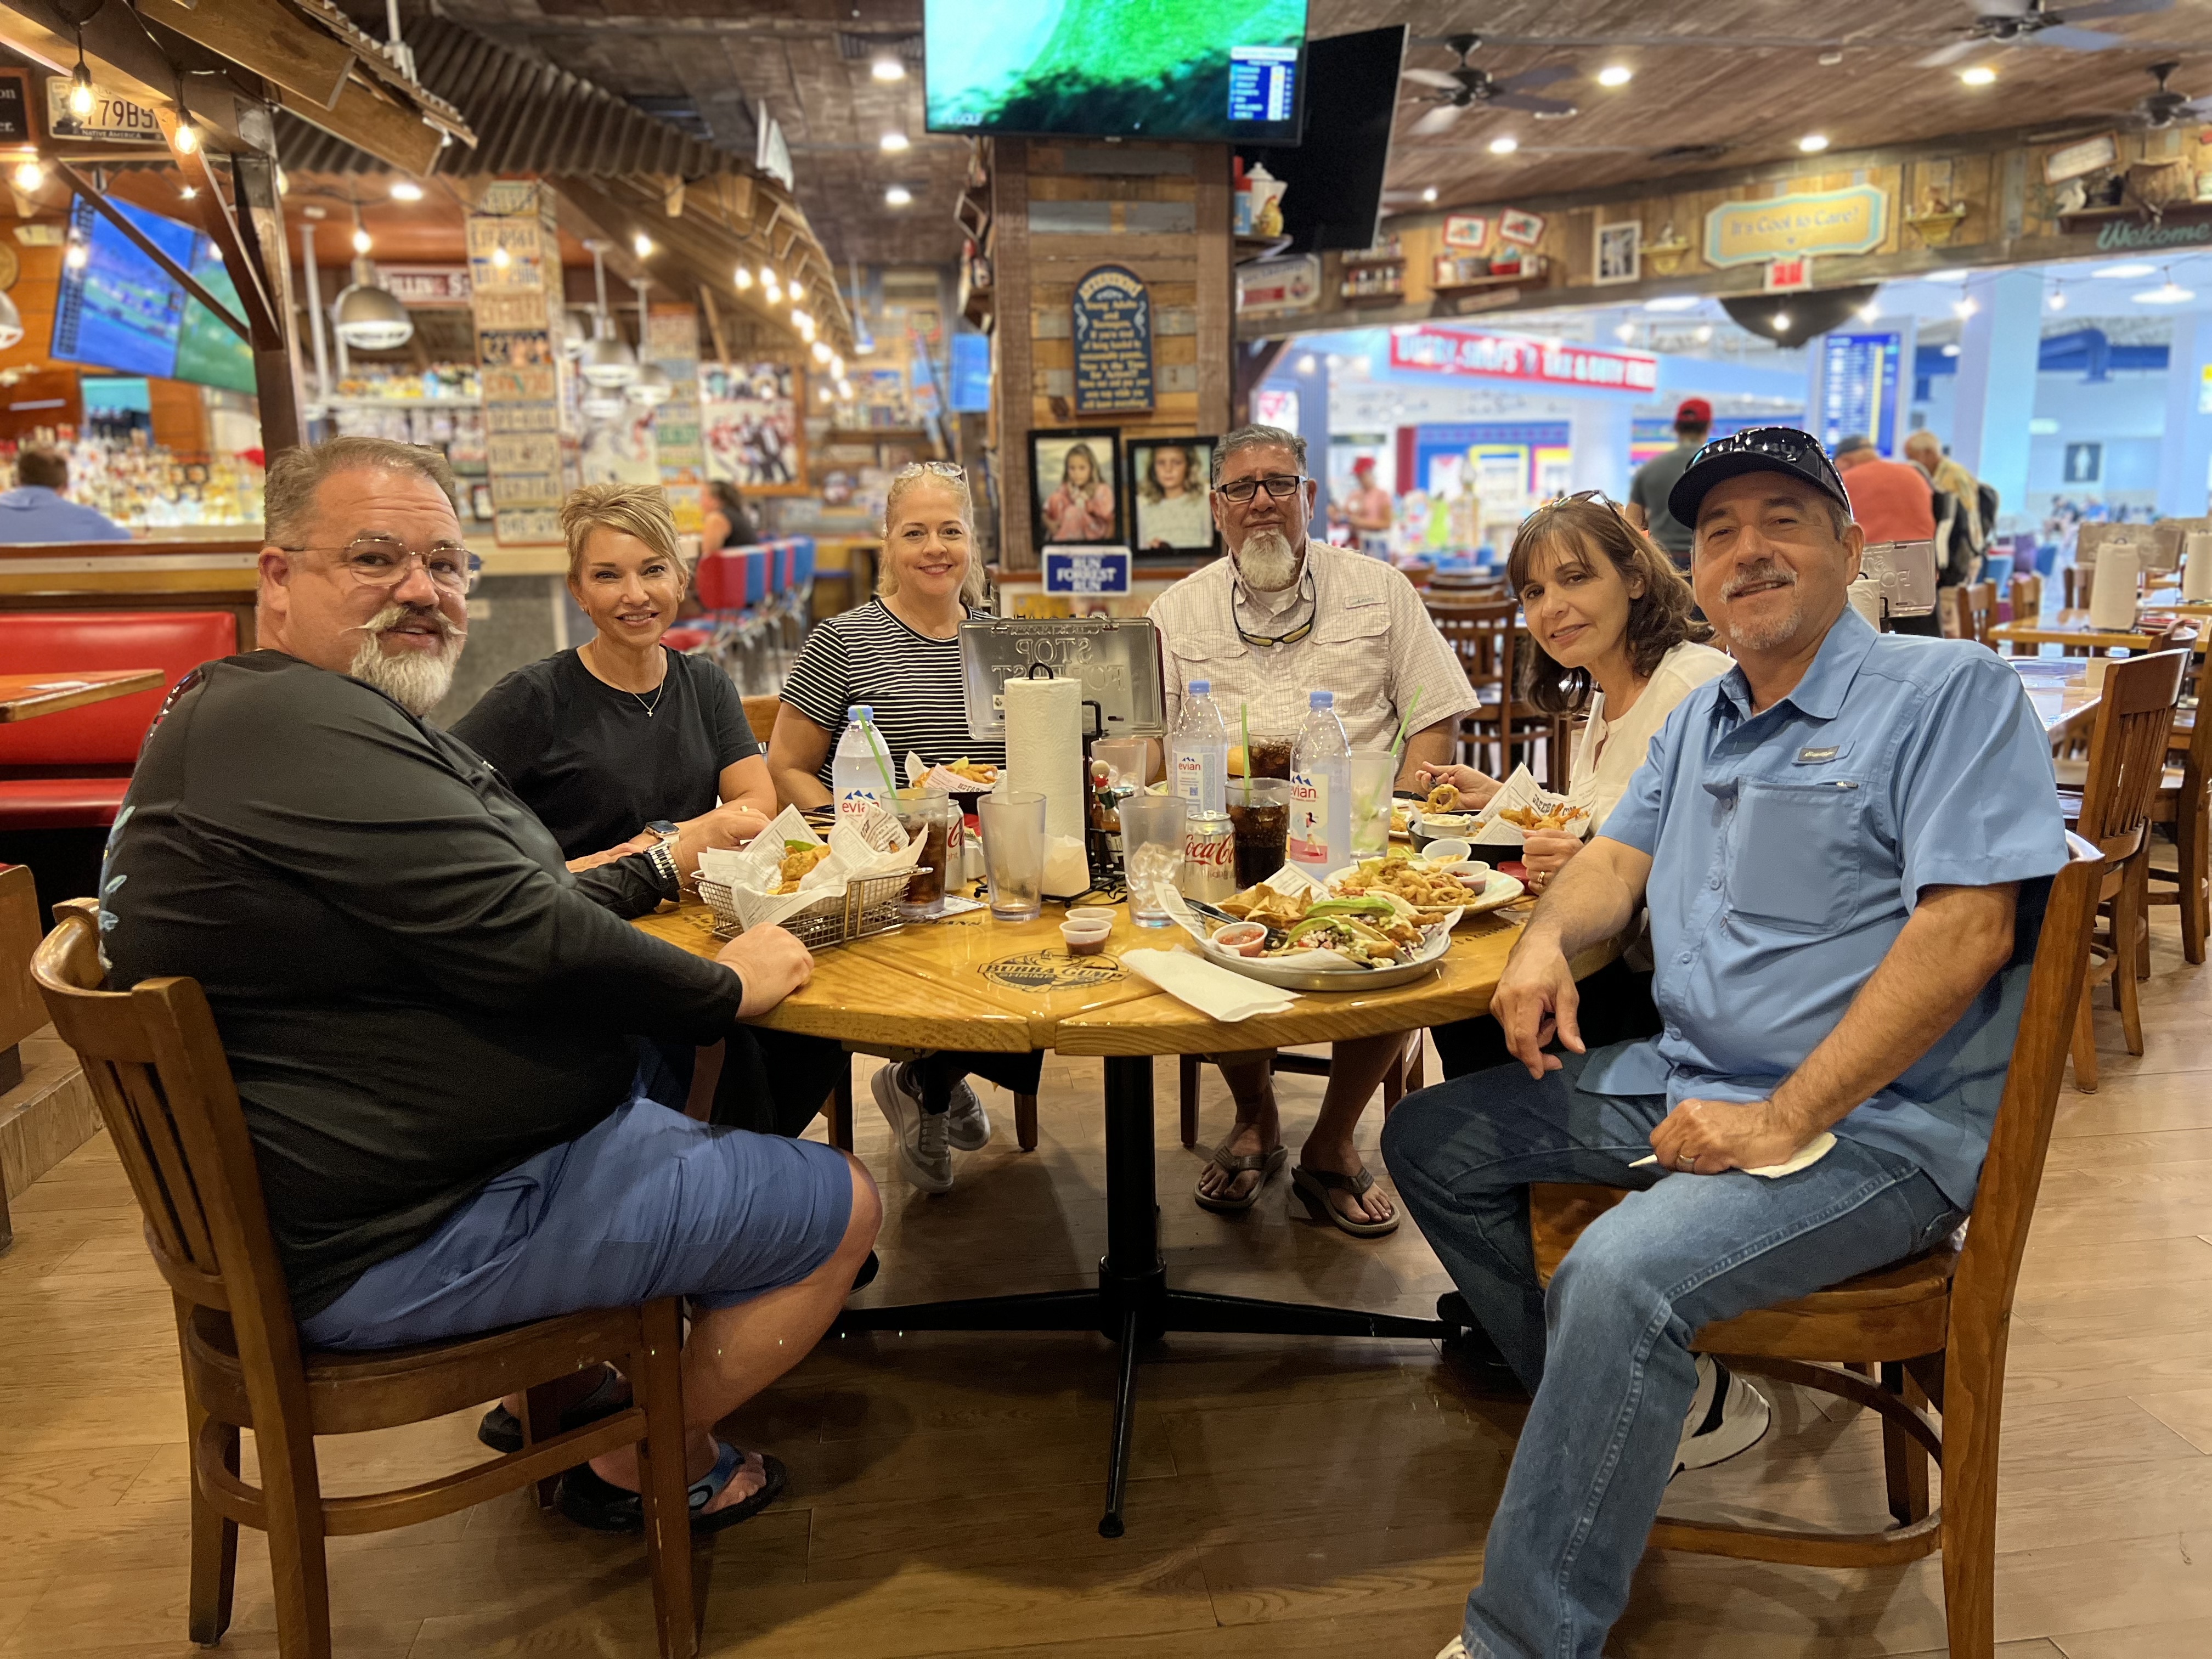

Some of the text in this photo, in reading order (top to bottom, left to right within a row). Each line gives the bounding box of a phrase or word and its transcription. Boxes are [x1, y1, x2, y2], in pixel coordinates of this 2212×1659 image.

[83, 129, 108, 138] NATIVE
[1757, 216, 1791, 234] Cool
[1796, 215, 1811, 228] to
[1815, 206, 1859, 225] Care!
[2097, 219, 2210, 250] Welcome
[1073, 557, 1102, 567] RUN
[1057, 567, 1117, 582] FORREST
[1073, 581, 1102, 591] RUN
[1178, 762, 1201, 771] evian
[986, 964, 1124, 981] BUBBA GUMP
